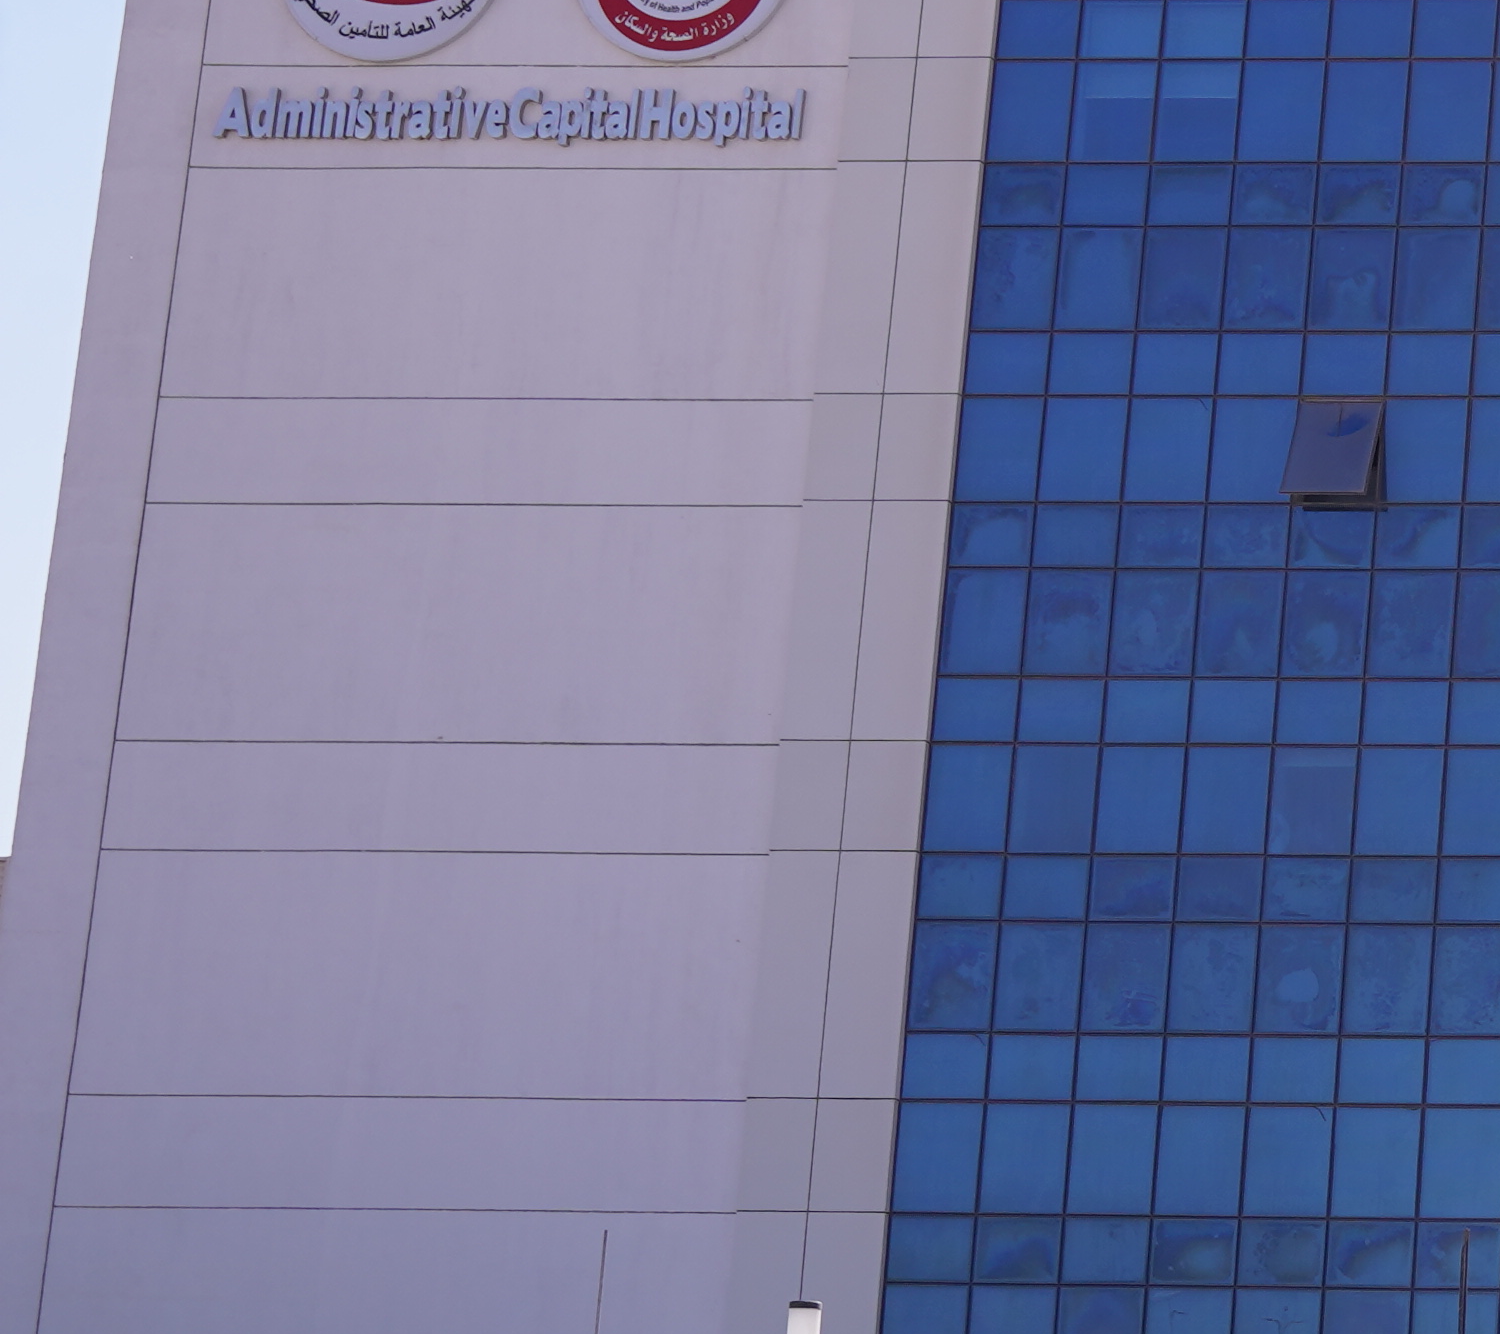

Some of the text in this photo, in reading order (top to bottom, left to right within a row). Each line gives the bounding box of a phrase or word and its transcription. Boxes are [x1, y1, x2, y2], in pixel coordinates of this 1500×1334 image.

[650, 0, 659, 10] of
[657, 3, 680, 13] Health
[681, 3, 695, 13] and
[393, 15, 436, 39] العامة
[660, 26, 699, 41] الصحة
[703, 13, 735, 36] وزارة
[212, 85, 807, 147] Administrative Capital Hospital
